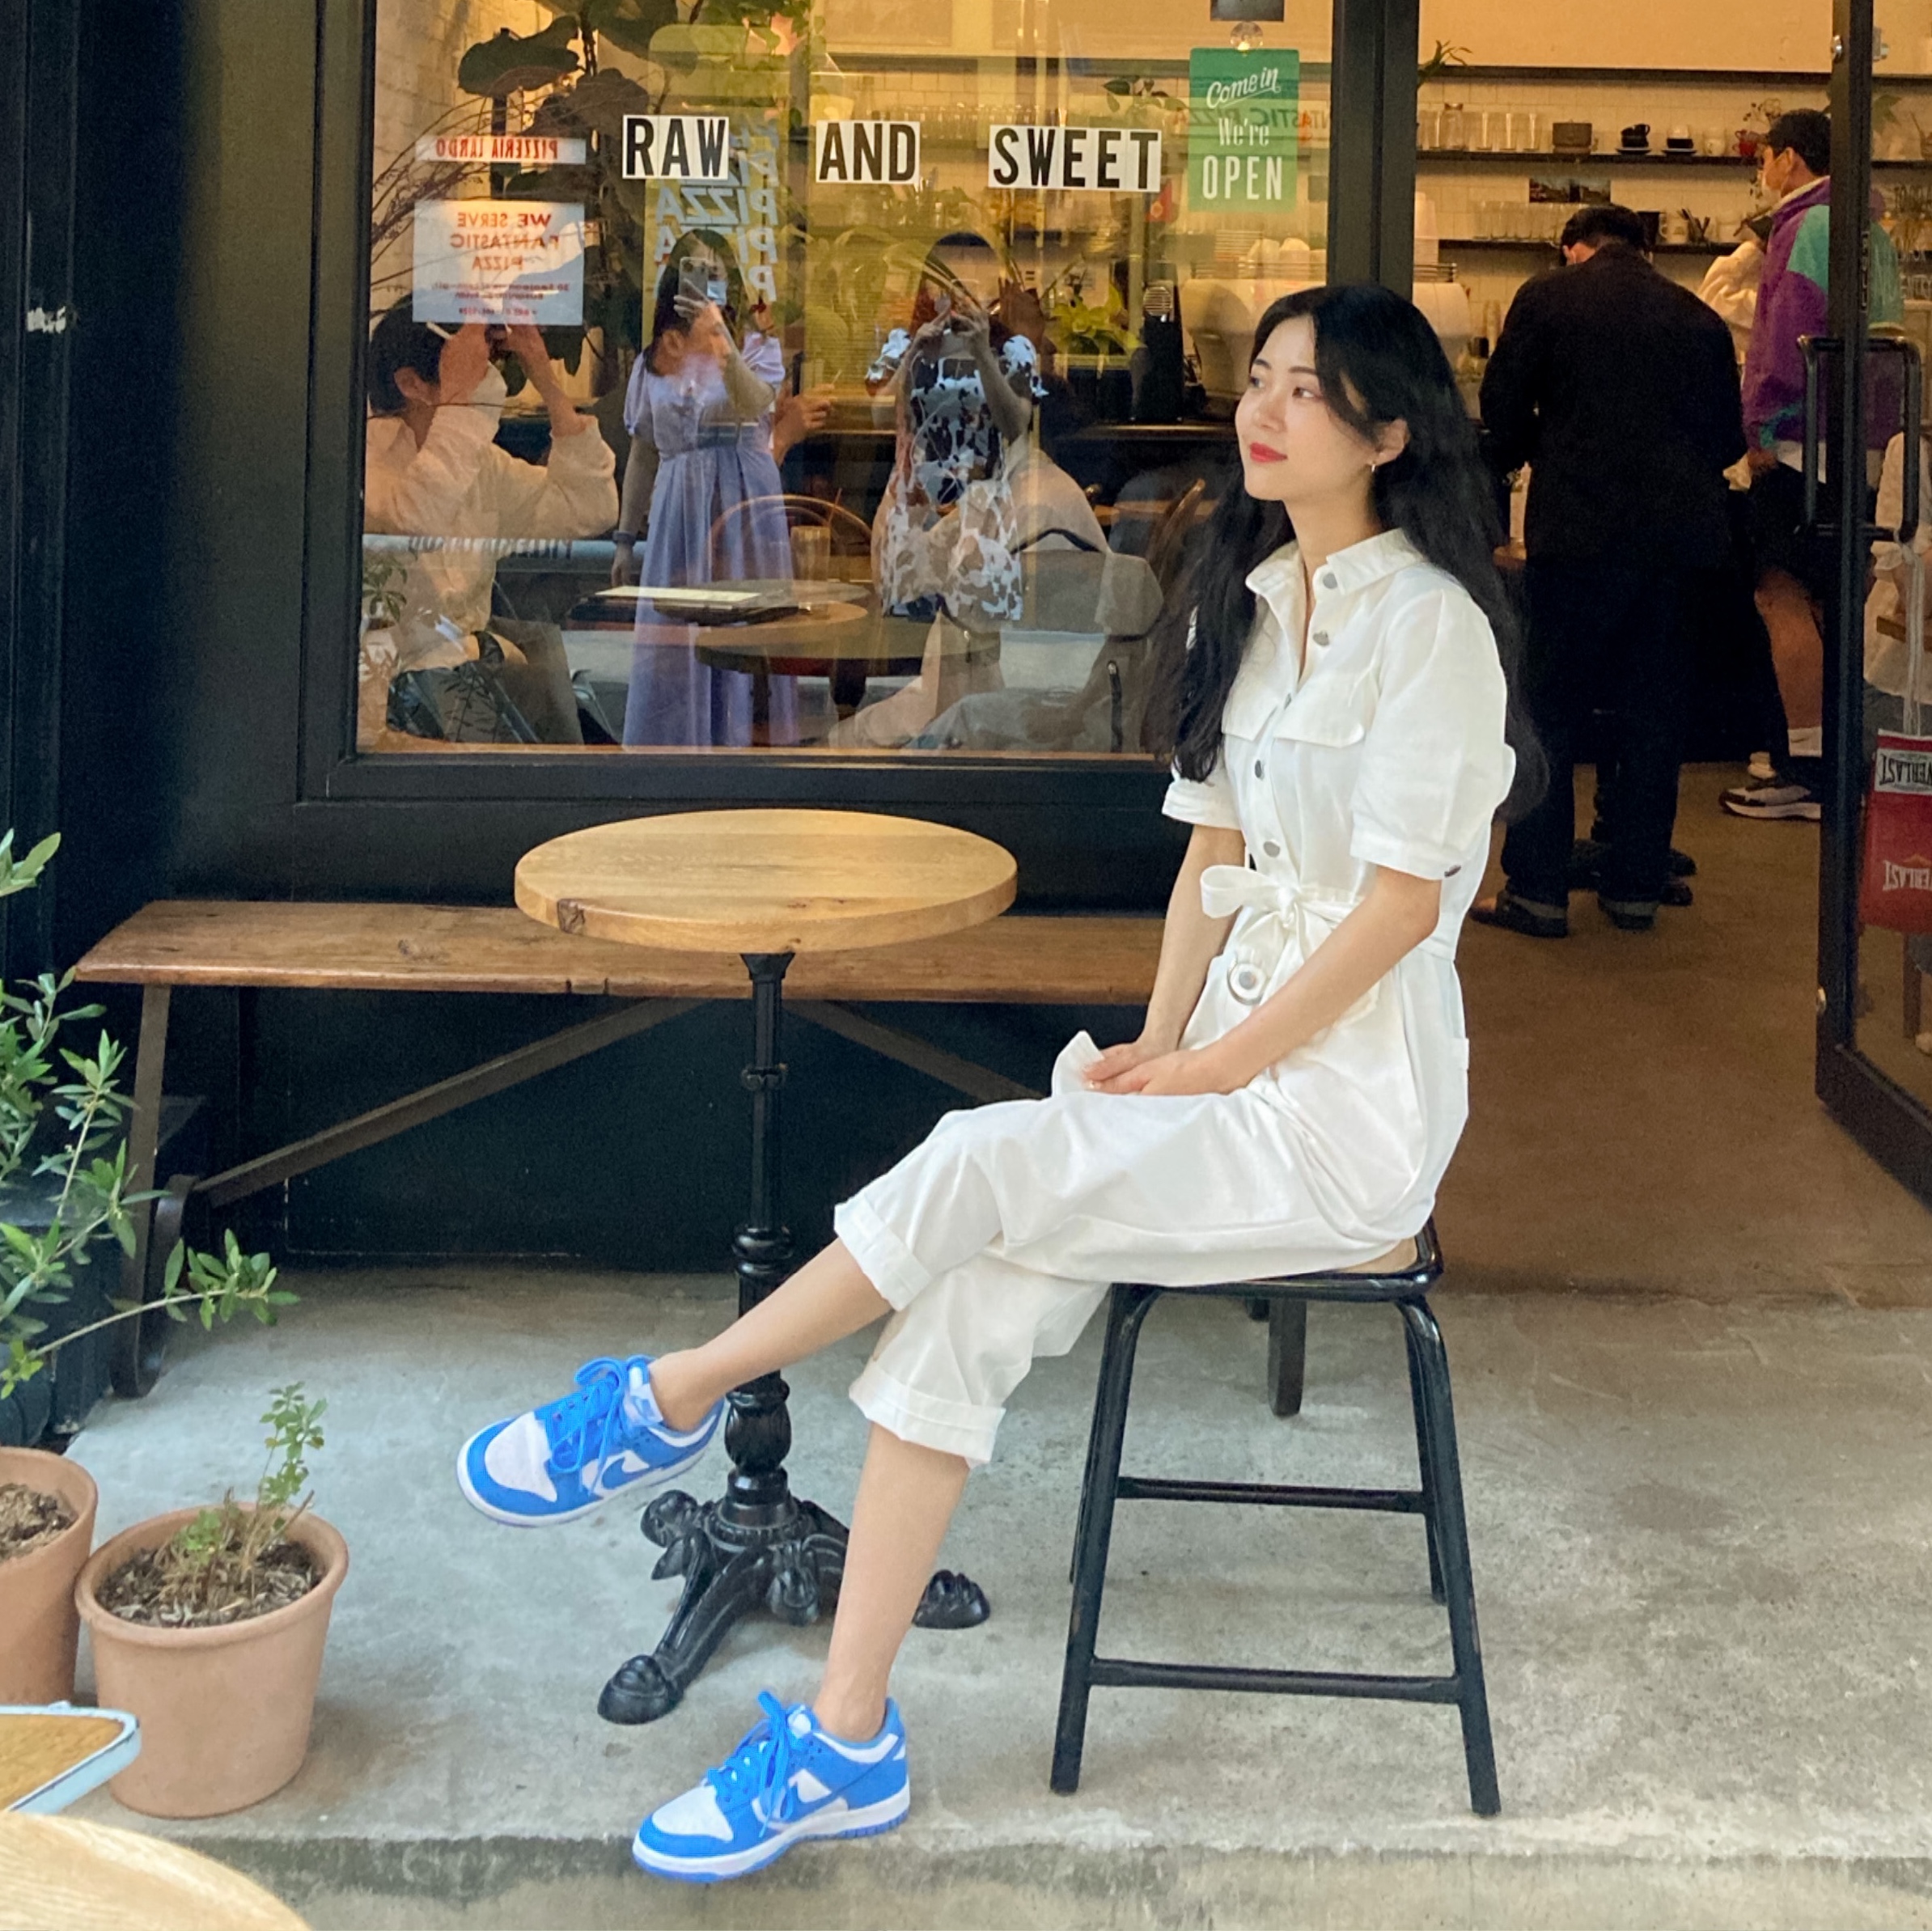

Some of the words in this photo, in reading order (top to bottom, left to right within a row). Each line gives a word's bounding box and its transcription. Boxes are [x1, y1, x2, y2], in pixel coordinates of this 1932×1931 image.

[1206, 74, 1259, 109] Come
[1260, 66, 1282, 94] in
[626, 117, 726, 177] RAW
[819, 122, 916, 181] AND
[993, 127, 1159, 190] SWEET
[1218, 118, 1269, 147] We're
[1202, 155, 1282, 201] OPEN
